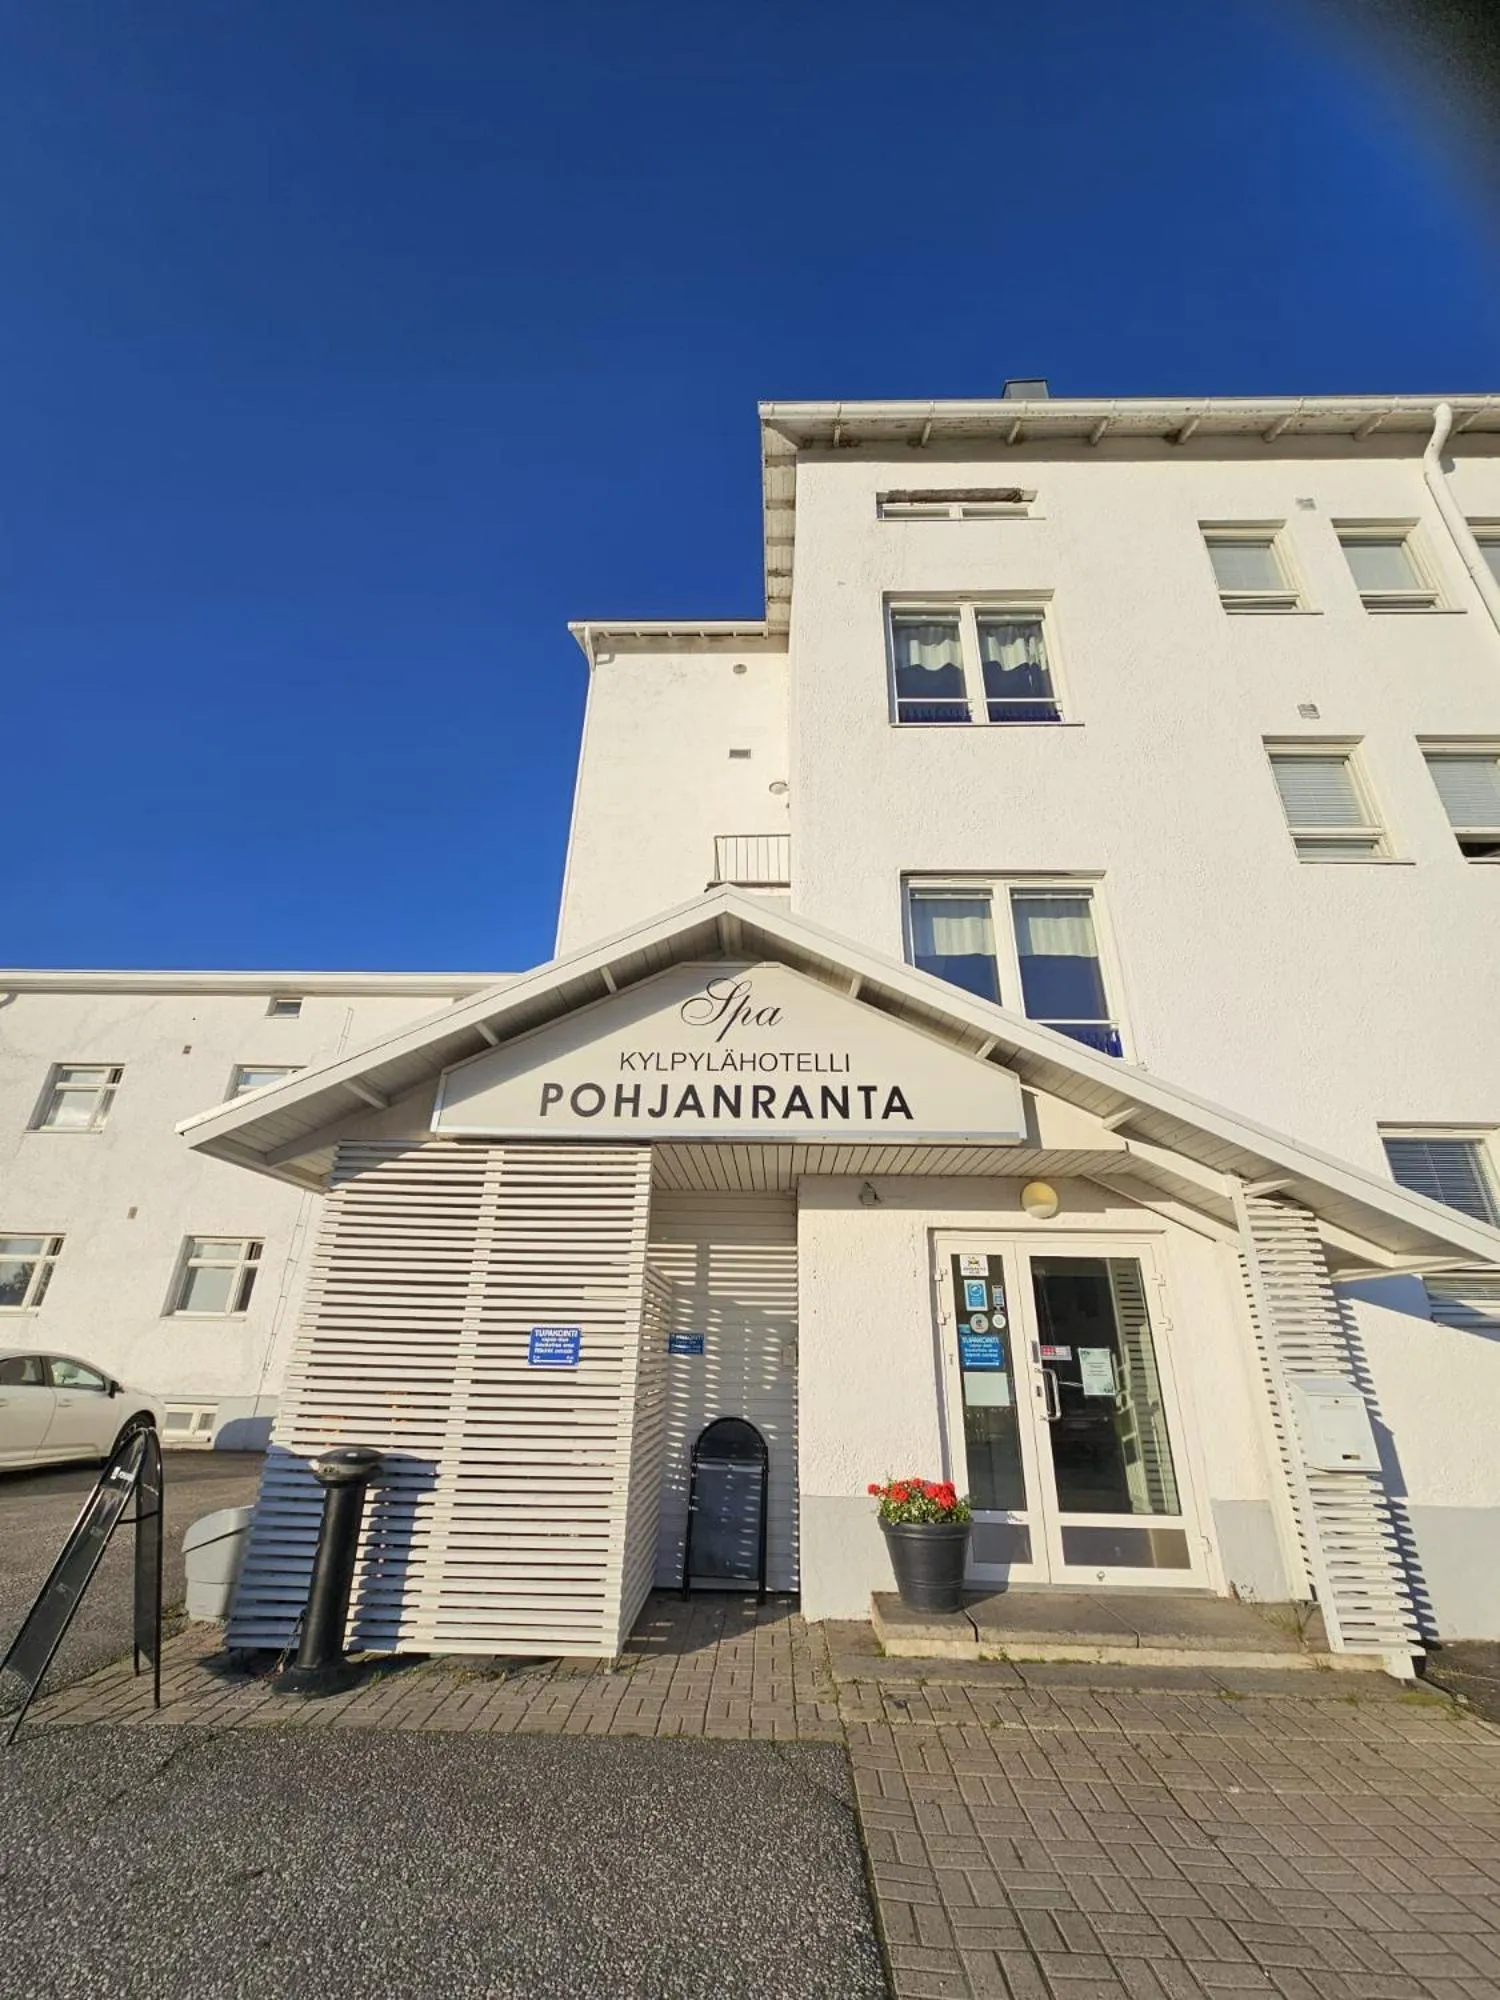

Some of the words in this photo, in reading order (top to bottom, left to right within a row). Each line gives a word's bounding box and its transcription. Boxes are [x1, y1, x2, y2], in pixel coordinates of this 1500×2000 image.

[680, 977, 784, 1043] Spa
[619, 1048, 851, 1073] KYLPYLÄHOTELLI
[539, 1082, 914, 1121] POHJANRANTA
